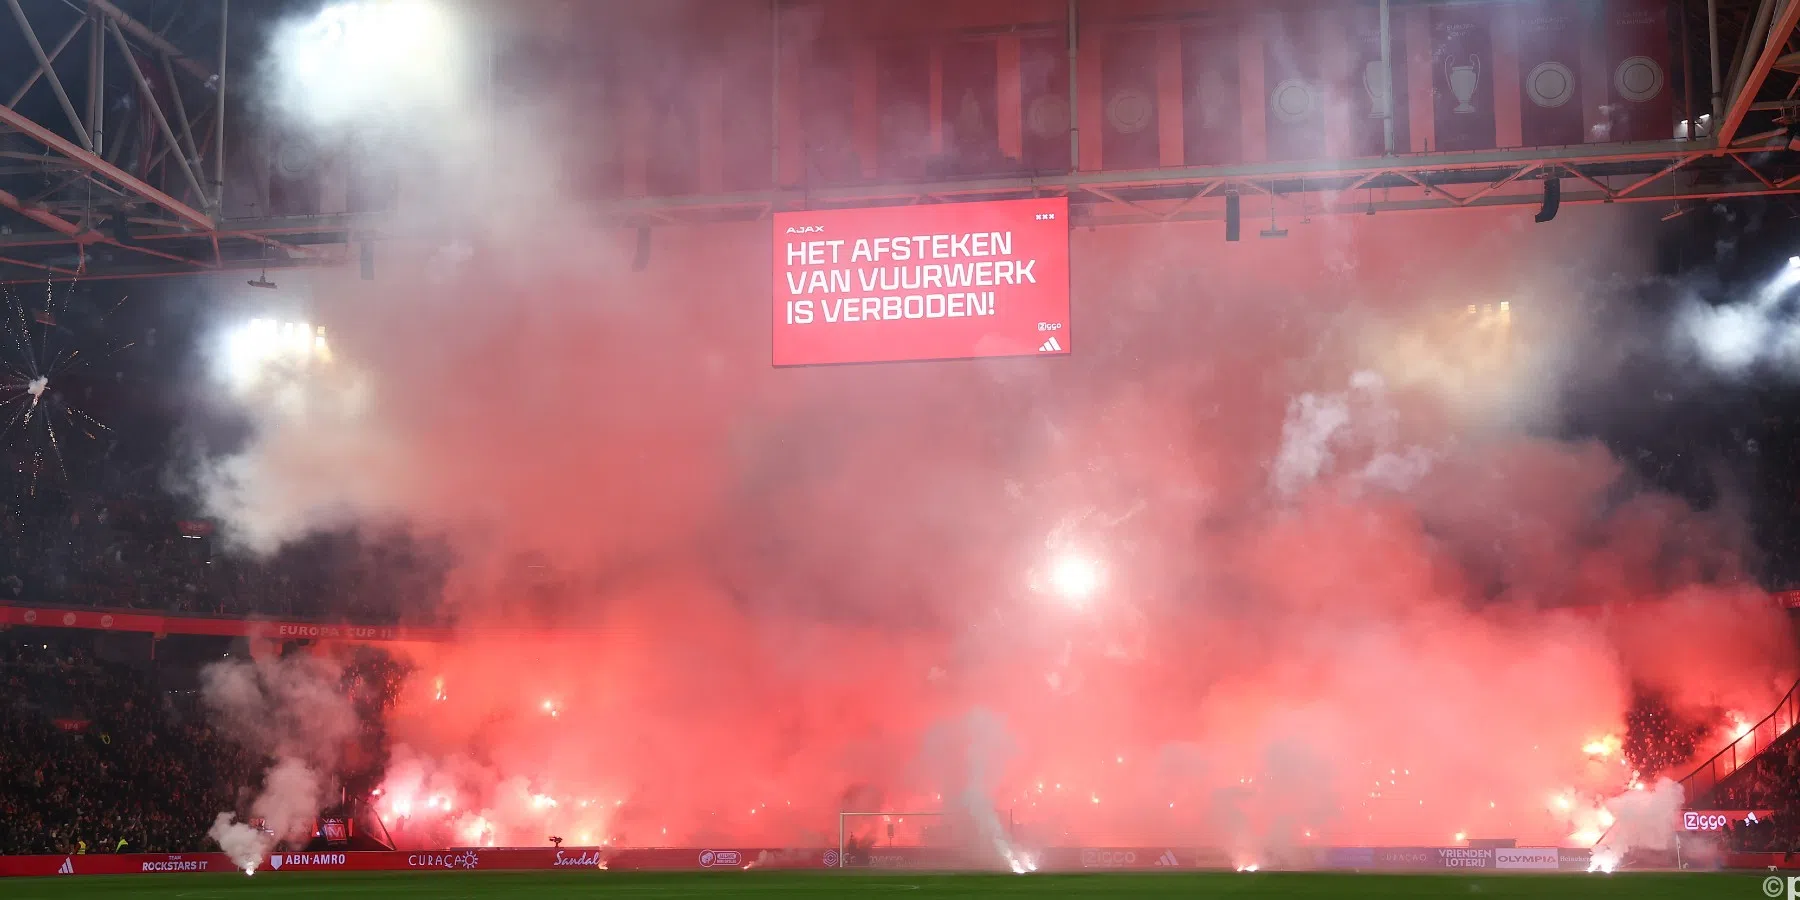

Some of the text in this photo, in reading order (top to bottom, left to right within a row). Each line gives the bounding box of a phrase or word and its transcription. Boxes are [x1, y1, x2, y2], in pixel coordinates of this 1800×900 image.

[786, 225, 825, 234] AJAX
[786, 231, 1012, 266] HET AFSTEKEN
[786, 259, 1037, 295] VAN VUURWERK
[786, 291, 995, 325] IS VERBODEN!
[279, 625, 340, 638] EUROPA
[348, 627, 376, 638] CUP
[1438, 849, 1492, 858] VRIENDEN
[1445, 858, 1486, 868] LOTERIJ
[1497, 855, 1557, 864] OLYMPIA
[142, 861, 208, 871] ROCKSTARS IT
